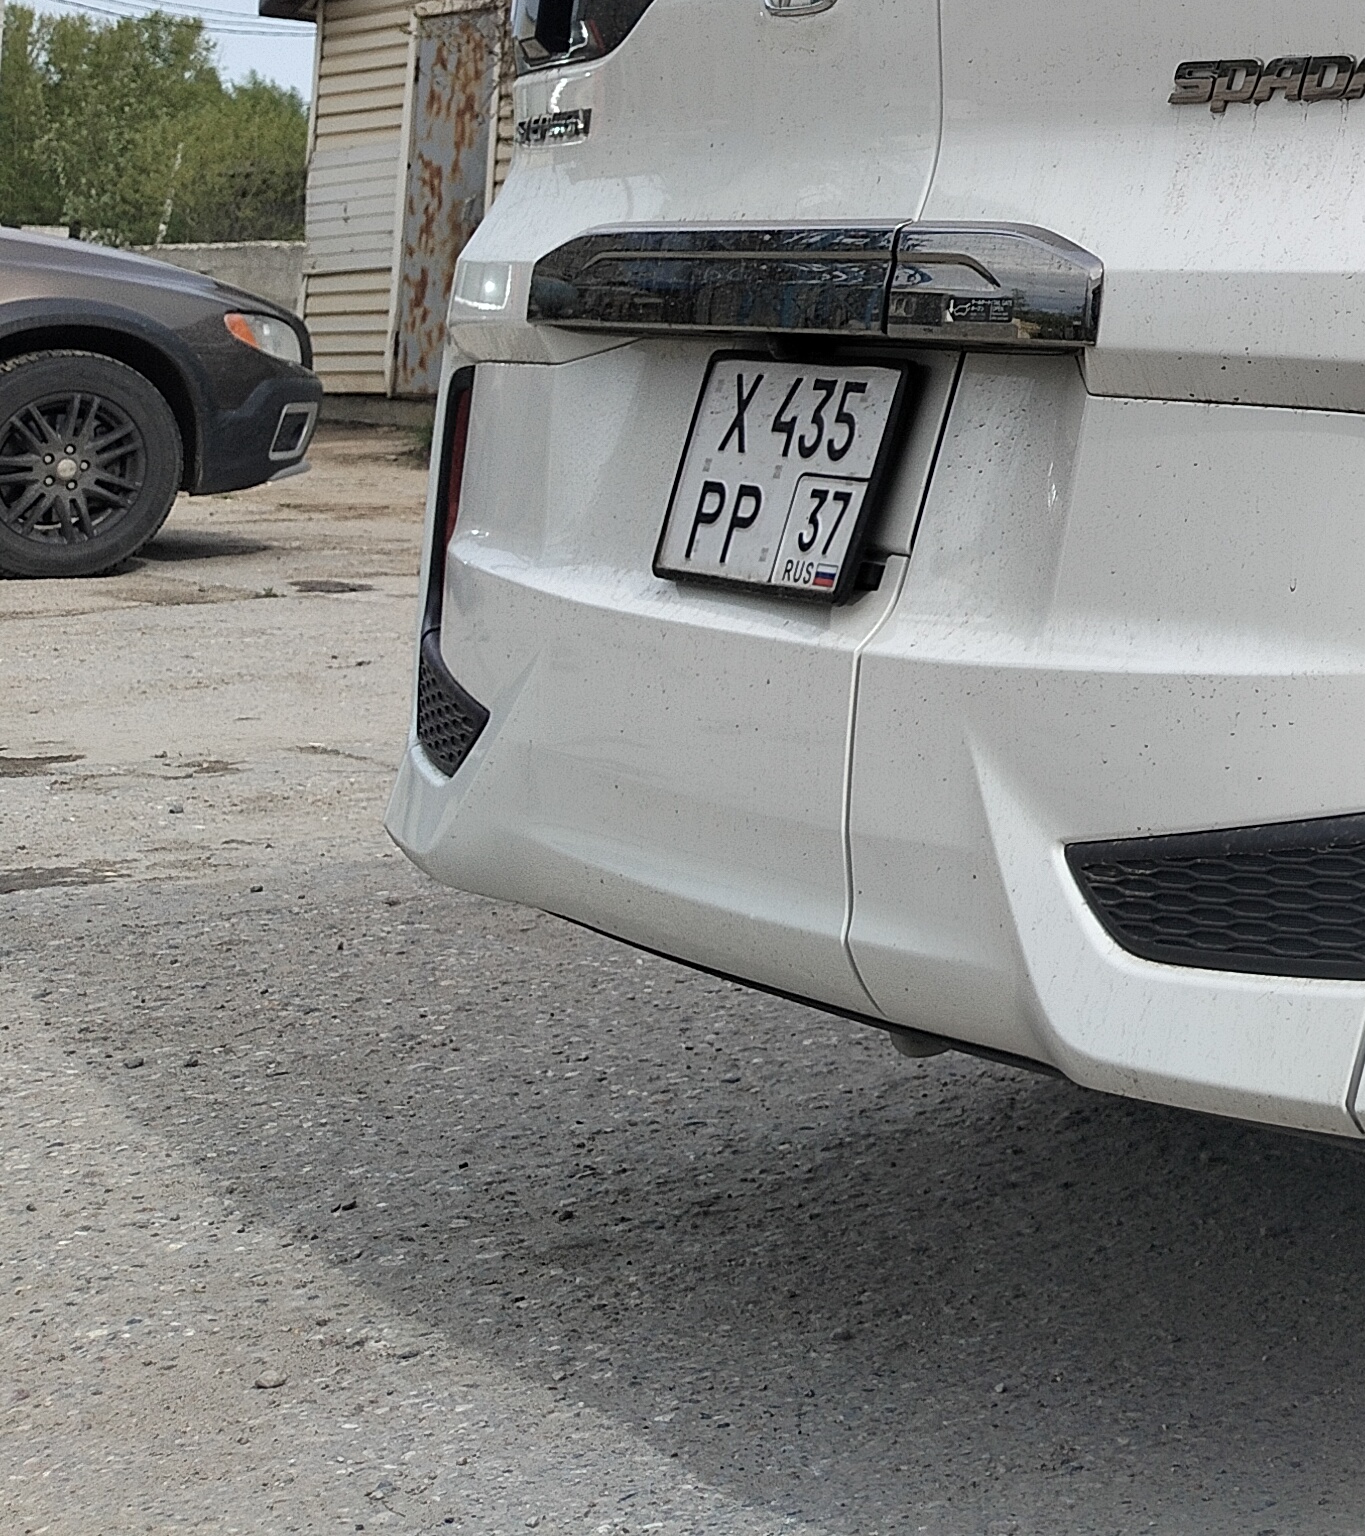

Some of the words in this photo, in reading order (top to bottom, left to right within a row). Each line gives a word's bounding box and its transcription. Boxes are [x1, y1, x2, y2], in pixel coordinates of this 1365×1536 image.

[718, 373, 764, 454] Х
[771, 377, 868, 462] 435
[685, 480, 762, 564] РР
[798, 489, 853, 555] 37
[782, 559, 814, 585] RUS
